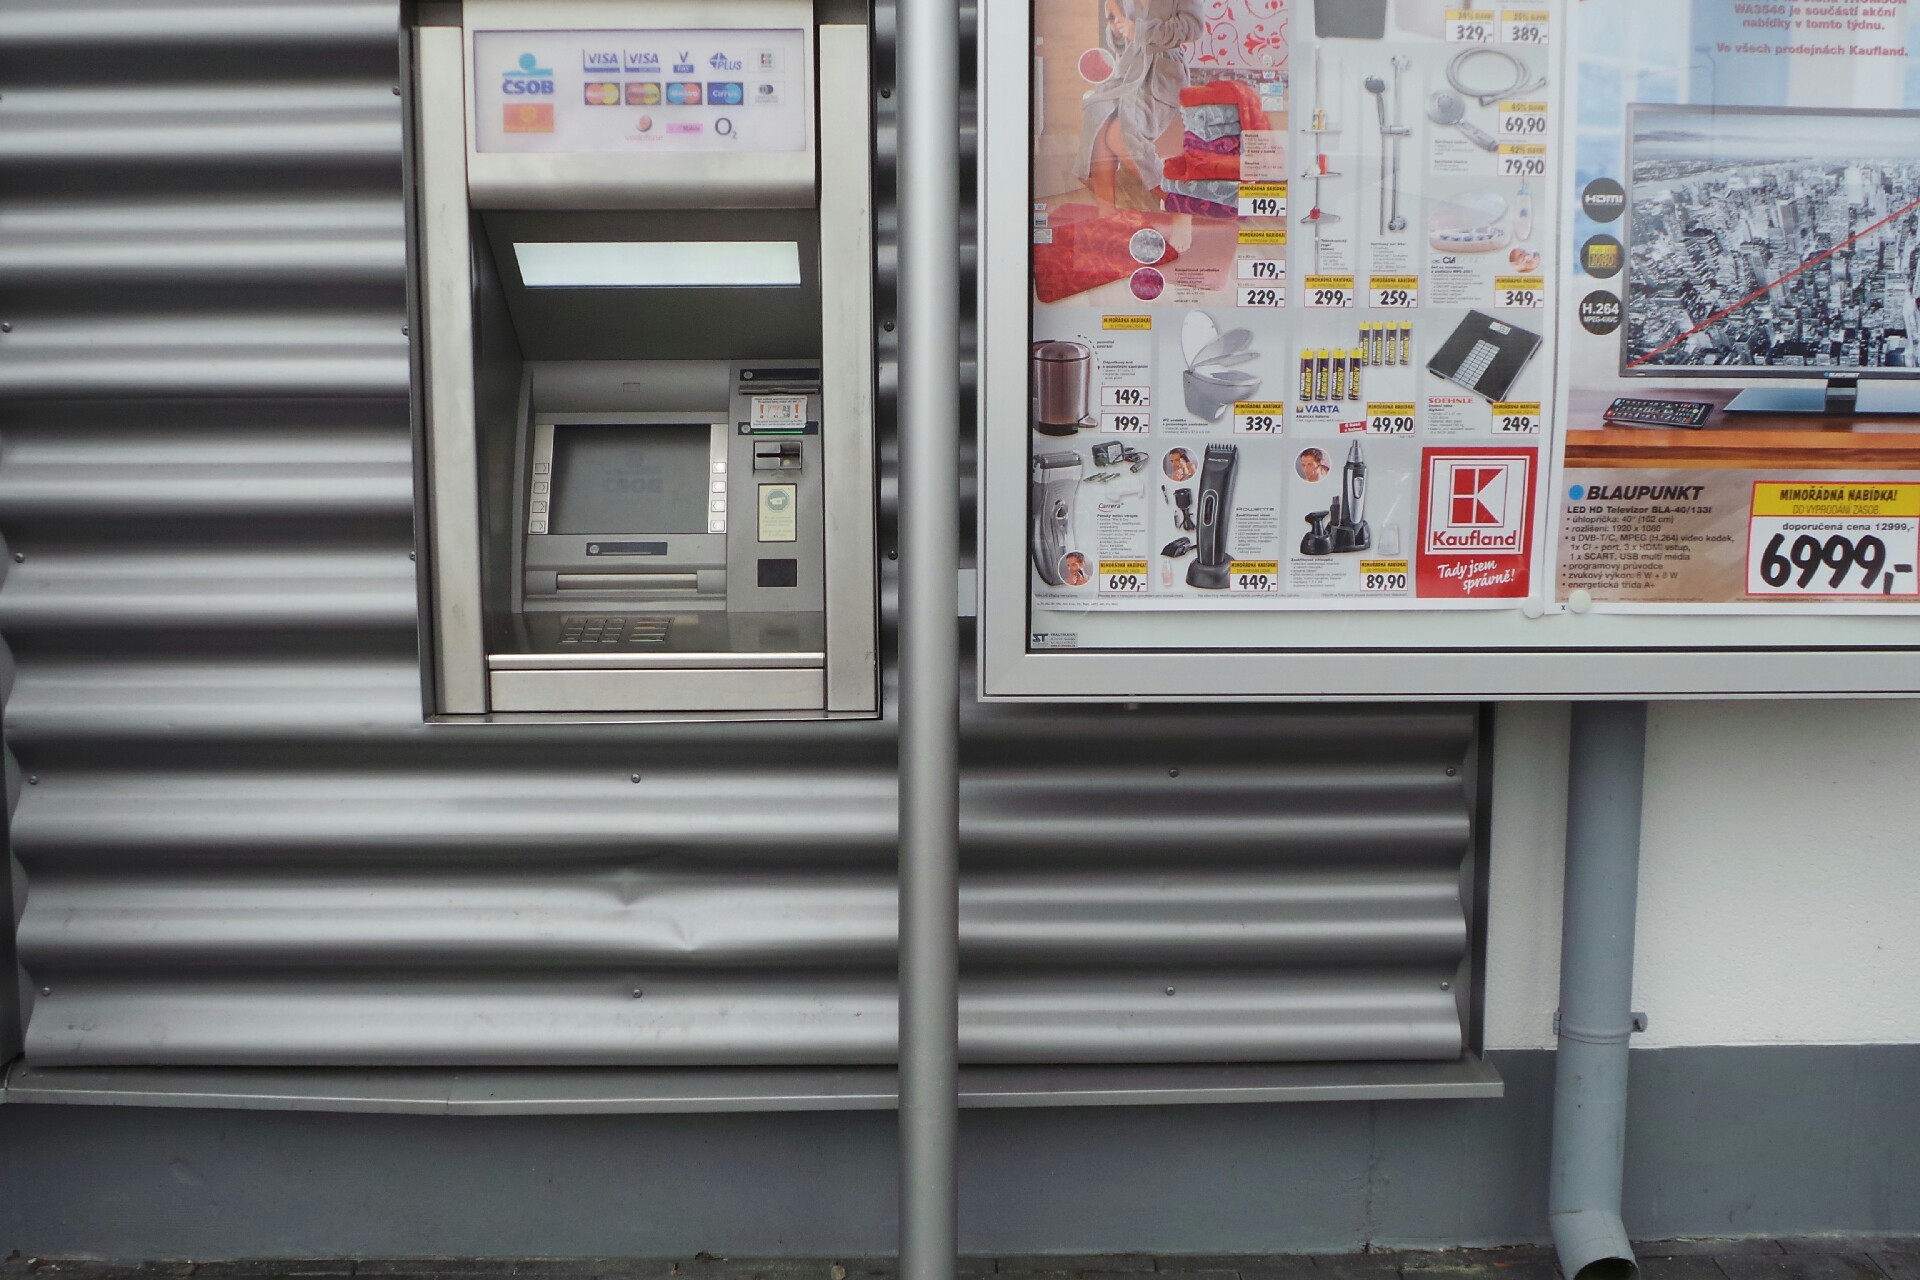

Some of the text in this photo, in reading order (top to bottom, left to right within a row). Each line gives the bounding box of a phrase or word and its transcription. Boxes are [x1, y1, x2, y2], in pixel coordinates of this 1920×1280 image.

[1789, 4, 1800, 17] je
[1805, 5, 1858, 16] součástí
[1862, 7, 1896, 17] akční
[1742, 18, 1790, 30] nabídky
[1806, 20, 1842, 29] tomto
[1847, 20, 1885, 31] týdnu.
[1457, 24, 1492, 43] 329,-
[1512, 25, 1548, 44] 389,-
[680, 51, 688, 63] V
[1717, 42, 1908, 56] Ve všech prodejnách Kaufland.
[589, 53, 618, 64] VISA
[630, 53, 659, 64] VISA
[718, 59, 742, 70] PLUS
[502, 79, 554, 95] ČSOB
[1506, 117, 1546, 134] 69,90
[1505, 160, 1544, 176] 79,90
[1585, 194, 1623, 203] HDMI
[1251, 198, 1286, 216] 149,-
[1252, 262, 1285, 279] 179,-
[1248, 290, 1284, 307] 229,-
[1315, 290, 1352, 307] 299,-
[1380, 290, 1416, 308] 259,-
[1506, 290, 1543, 308] 349,-
[1582, 303, 1619, 315] H.264
[1115, 389, 1148, 406] 149,-
[1305, 405, 1340, 413] VARTA
[1114, 416, 1148, 433] 199,-
[1246, 416, 1281, 433] 339,-
[1373, 417, 1414, 434] 49,90
[1503, 416, 1539, 434] 249,-
[1587, 486, 1704, 500] BLAUPUNKT
[1780, 486, 1898, 501] MIMOŘÁDNÁ NABÍDKA!
[1572, 515, 1619, 523] úhlopříčka:
[1782, 523, 1842, 532] doporučená
[1876, 523, 1914, 532] 12999,-
[1433, 530, 1517, 546] Kaufland
[1578, 534, 1617, 542] DVB-T/C,
[1650, 534, 1678, 542] (H.264)
[1706, 535, 1734, 543] kodek,
[1584, 553, 1617, 561] SCART,
[1760, 533, 1913, 594] 6999,-
[1438, 560, 1497, 579] Tady jsem
[1623, 562, 1663, 570] průvodce
[1110, 575, 1146, 592] 699,-
[1239, 575, 1276, 591] 449,-
[1367, 574, 1406, 591] 89,90
[1463, 569, 1515, 594] správně!
[1568, 581, 1619, 589] energetická
